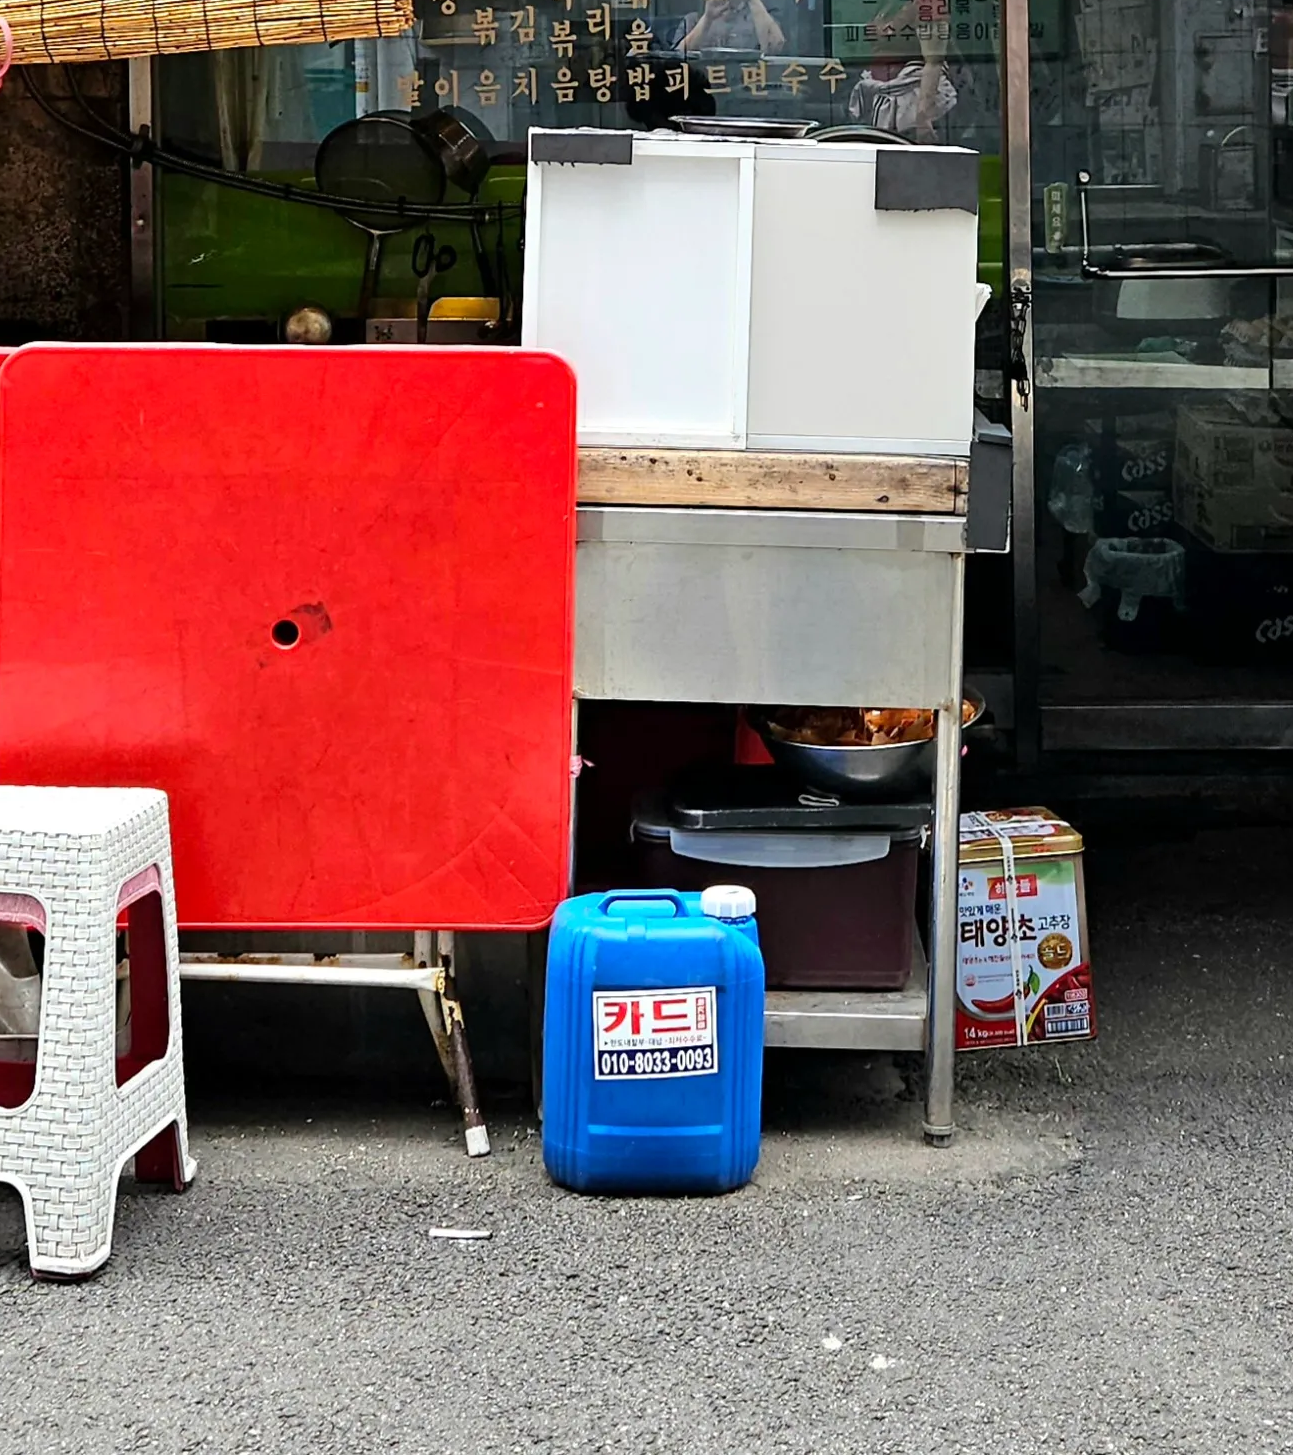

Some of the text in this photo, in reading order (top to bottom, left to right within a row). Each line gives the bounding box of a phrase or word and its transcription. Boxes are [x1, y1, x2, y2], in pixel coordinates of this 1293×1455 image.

[960, 913, 1071, 948] 태양초 고추장
[602, 998, 692, 1035] 카드
[601, 1047, 713, 1075] 010-8033-0093
